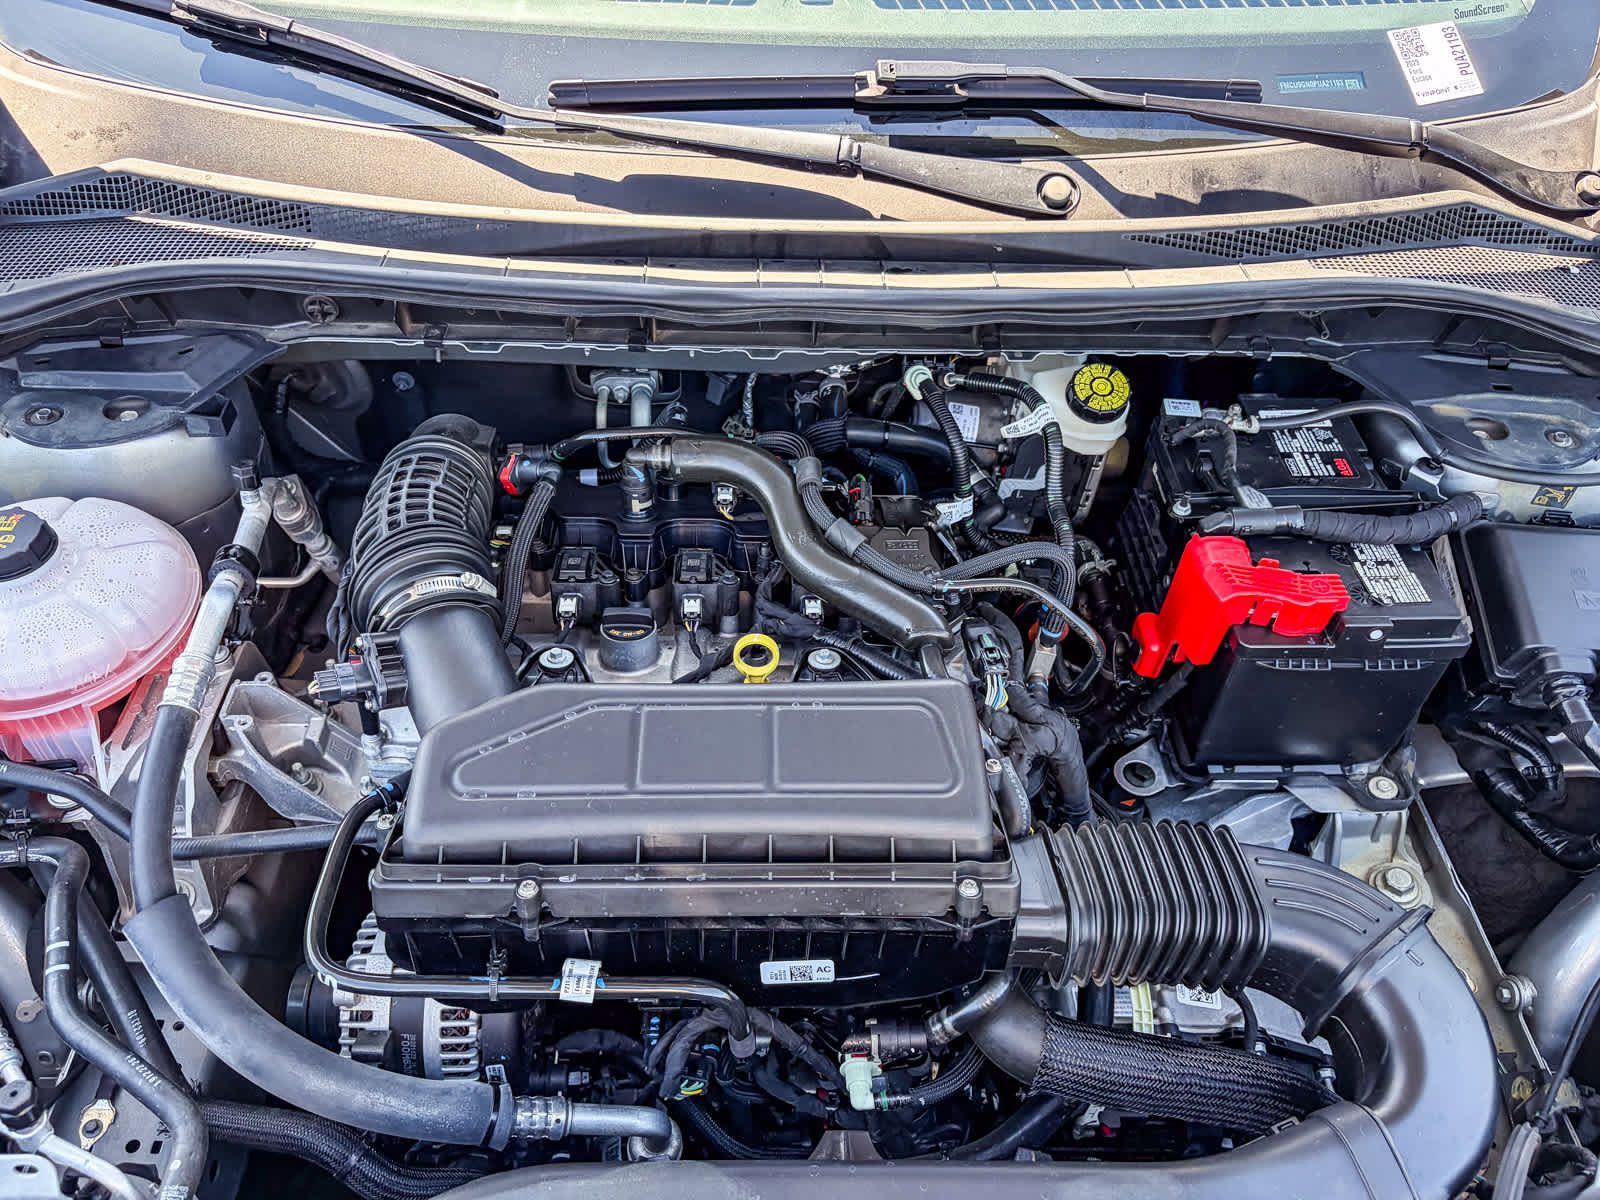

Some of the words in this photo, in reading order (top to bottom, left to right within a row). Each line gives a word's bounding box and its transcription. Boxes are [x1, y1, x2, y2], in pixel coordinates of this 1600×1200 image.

[1454, 4, 1504, 20] SoundScreen
[1441, 26, 1473, 76] PUA21193
[816, 965, 832, 974] AC
